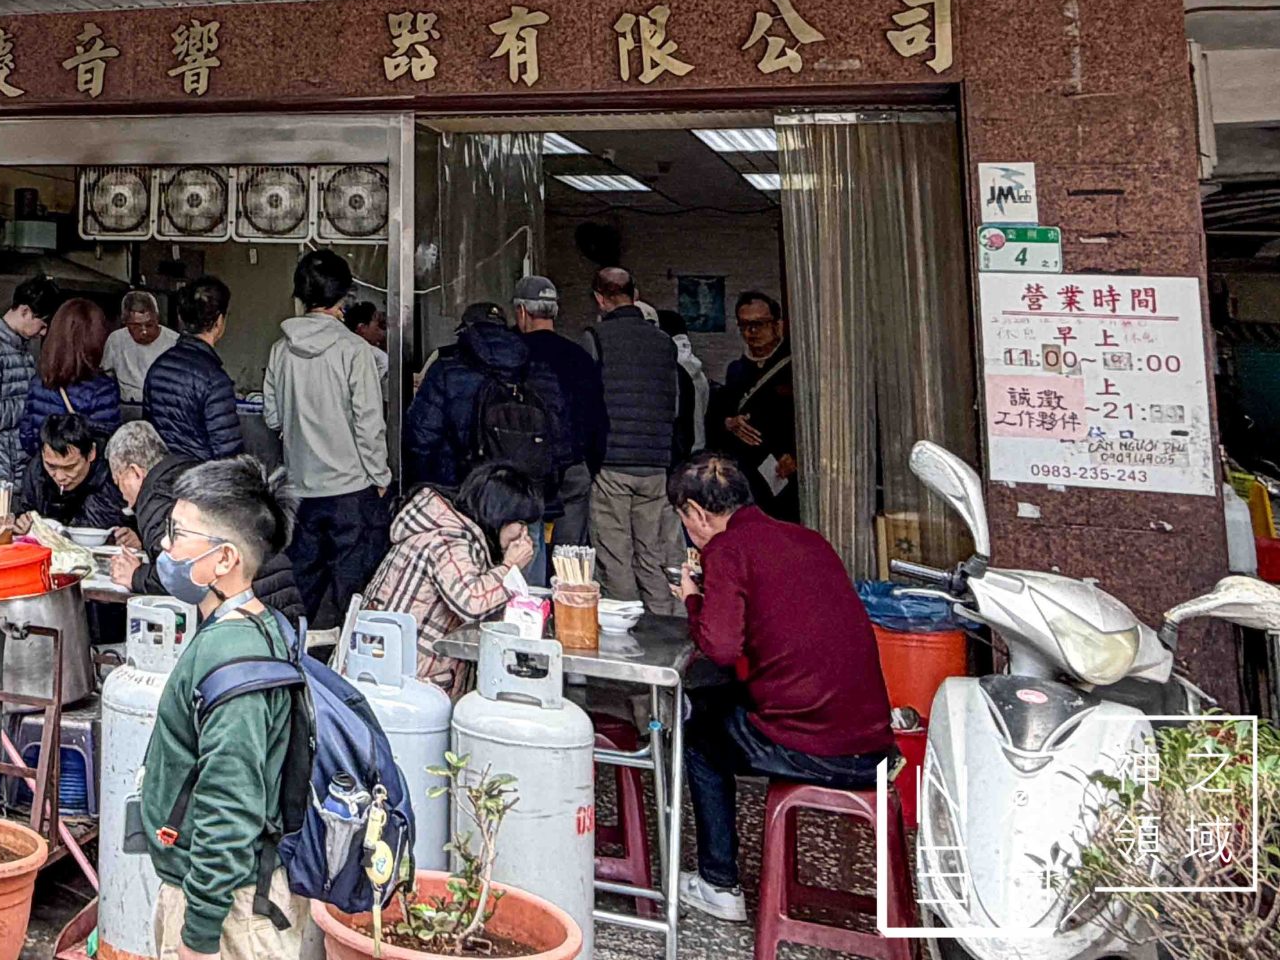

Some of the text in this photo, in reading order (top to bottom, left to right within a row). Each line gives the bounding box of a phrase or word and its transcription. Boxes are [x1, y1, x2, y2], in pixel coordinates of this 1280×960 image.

[1014, 247, 1028, 266] 4
[1021, 283, 1157, 314] 營業時間
[1053, 326, 1120, 347] 早上
[994, 410, 1082, 432] 工作夥伴
[1031, 464, 1148, 483] 0983-235-243
